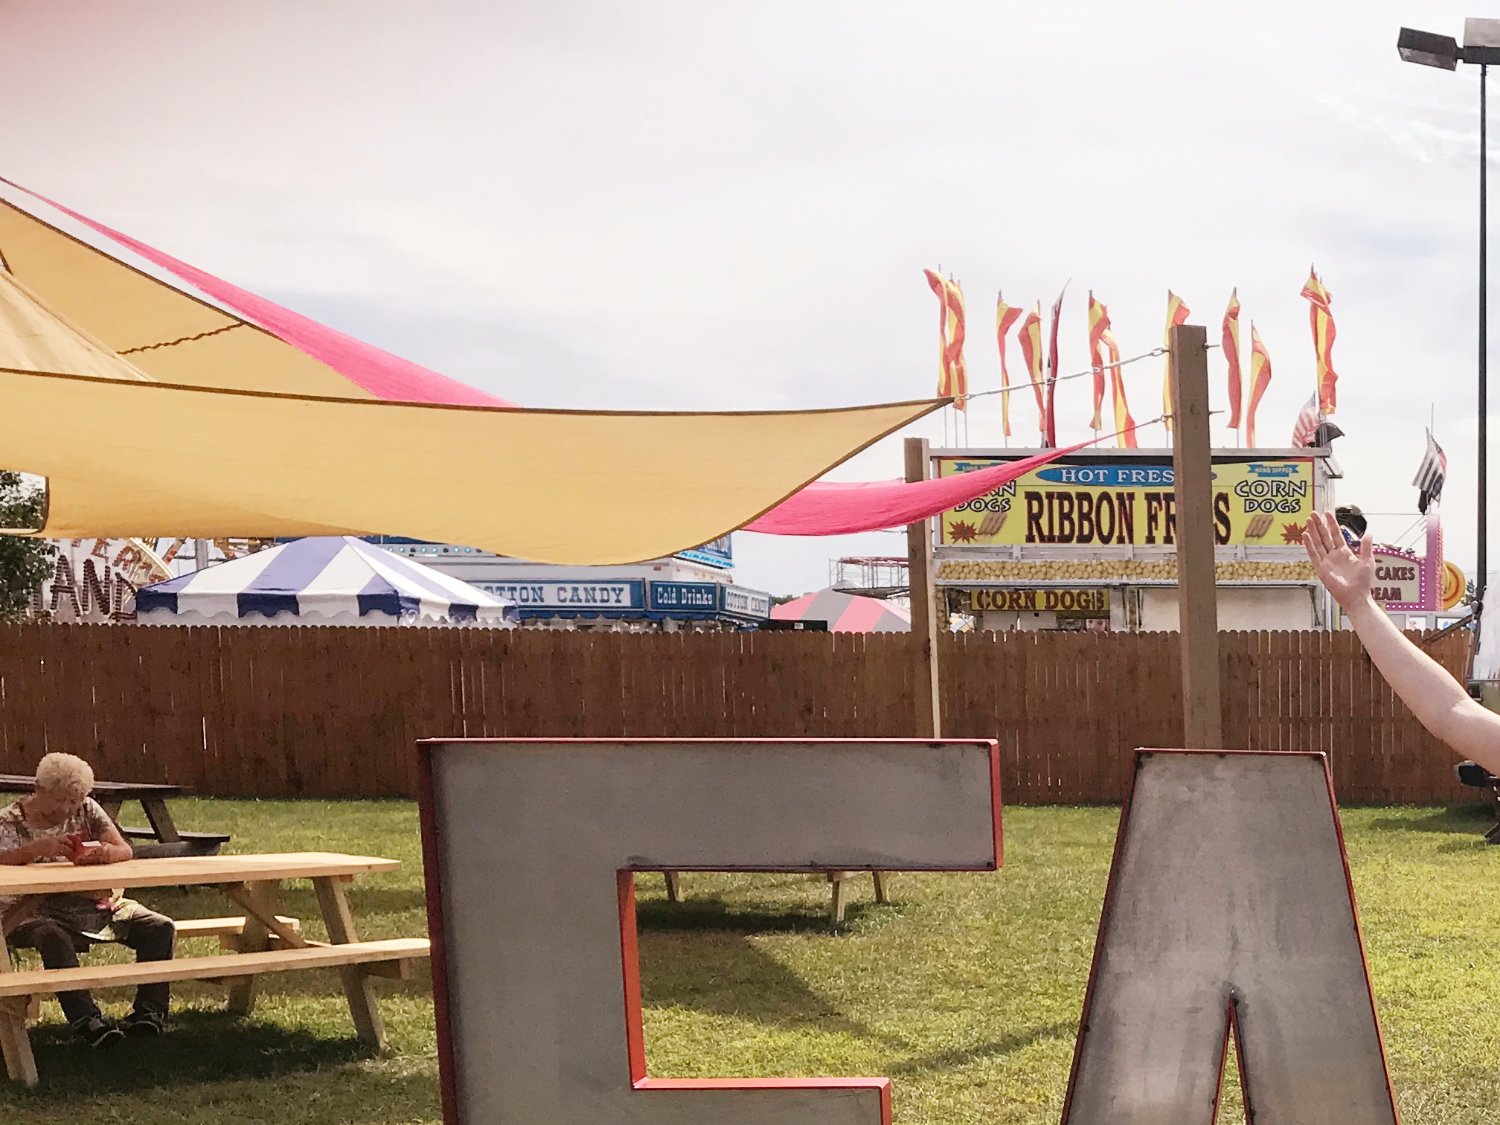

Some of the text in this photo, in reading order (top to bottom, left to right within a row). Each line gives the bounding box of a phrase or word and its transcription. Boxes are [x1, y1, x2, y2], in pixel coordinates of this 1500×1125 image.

[1061, 469, 1174, 483] HOT FRES
[1235, 480, 1307, 498] CORN
[1244, 498, 1301, 513] DOGS
[1024, 491, 1232, 545] RIBBON FRS
[1375, 567, 1415, 581] CAKES
[477, 585, 624, 604] OTTON CANDY
[657, 587, 713, 605] Cold Drinks
[976, 589, 1105, 611] CORN DOGS
